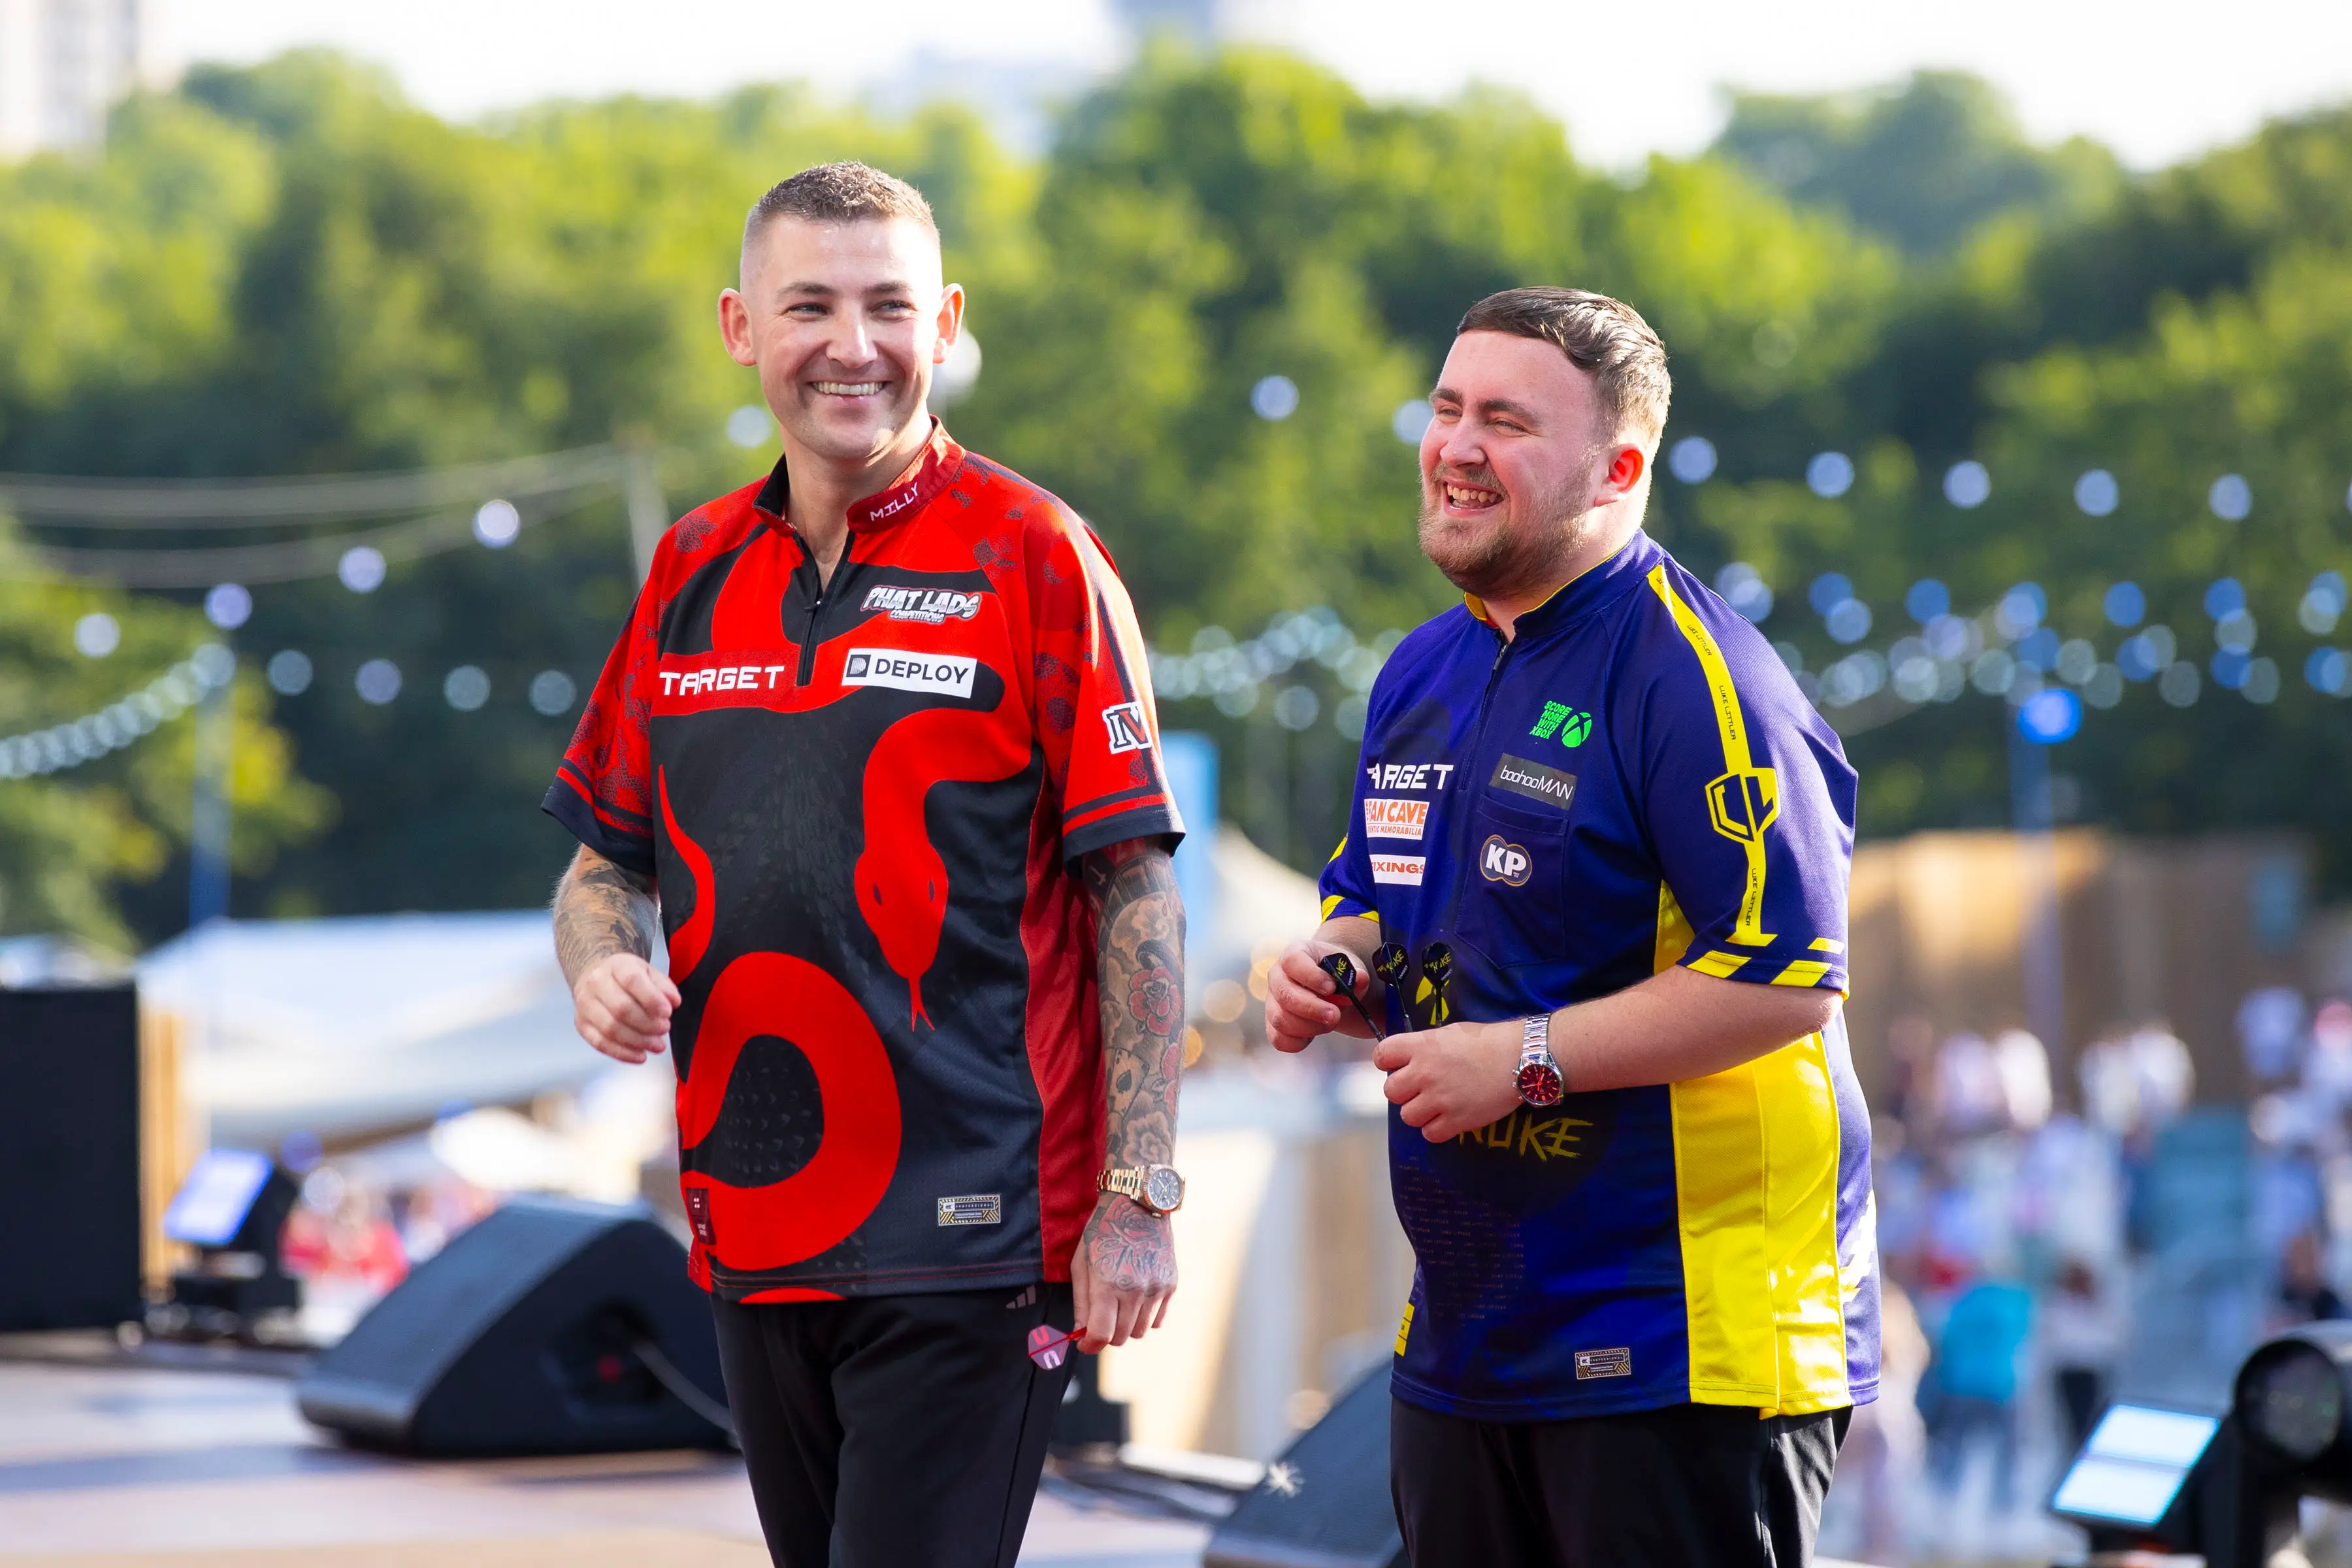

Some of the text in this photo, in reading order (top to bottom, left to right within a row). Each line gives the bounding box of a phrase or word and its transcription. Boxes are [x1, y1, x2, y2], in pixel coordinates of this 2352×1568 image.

[870, 482, 918, 521] MILLY
[862, 587, 980, 618] PHAT LADS
[659, 665, 784, 696] TARGET
[875, 659, 970, 685] DEPLOY
[1541, 710, 1567, 723] MORE
[1544, 700, 1573, 716] SCORE
[1719, 685, 1737, 740] LUKE LITTLER
[1529, 726, 1553, 739] XBOX
[1537, 718, 1560, 731] WITH
[1500, 764, 1574, 800] boohooMAN
[1387, 801, 1428, 825] CAVE
[1380, 825, 1422, 836] MEMORABILIA
[1486, 843, 1527, 876] KP
[1746, 891, 1757, 926] LITTLER
